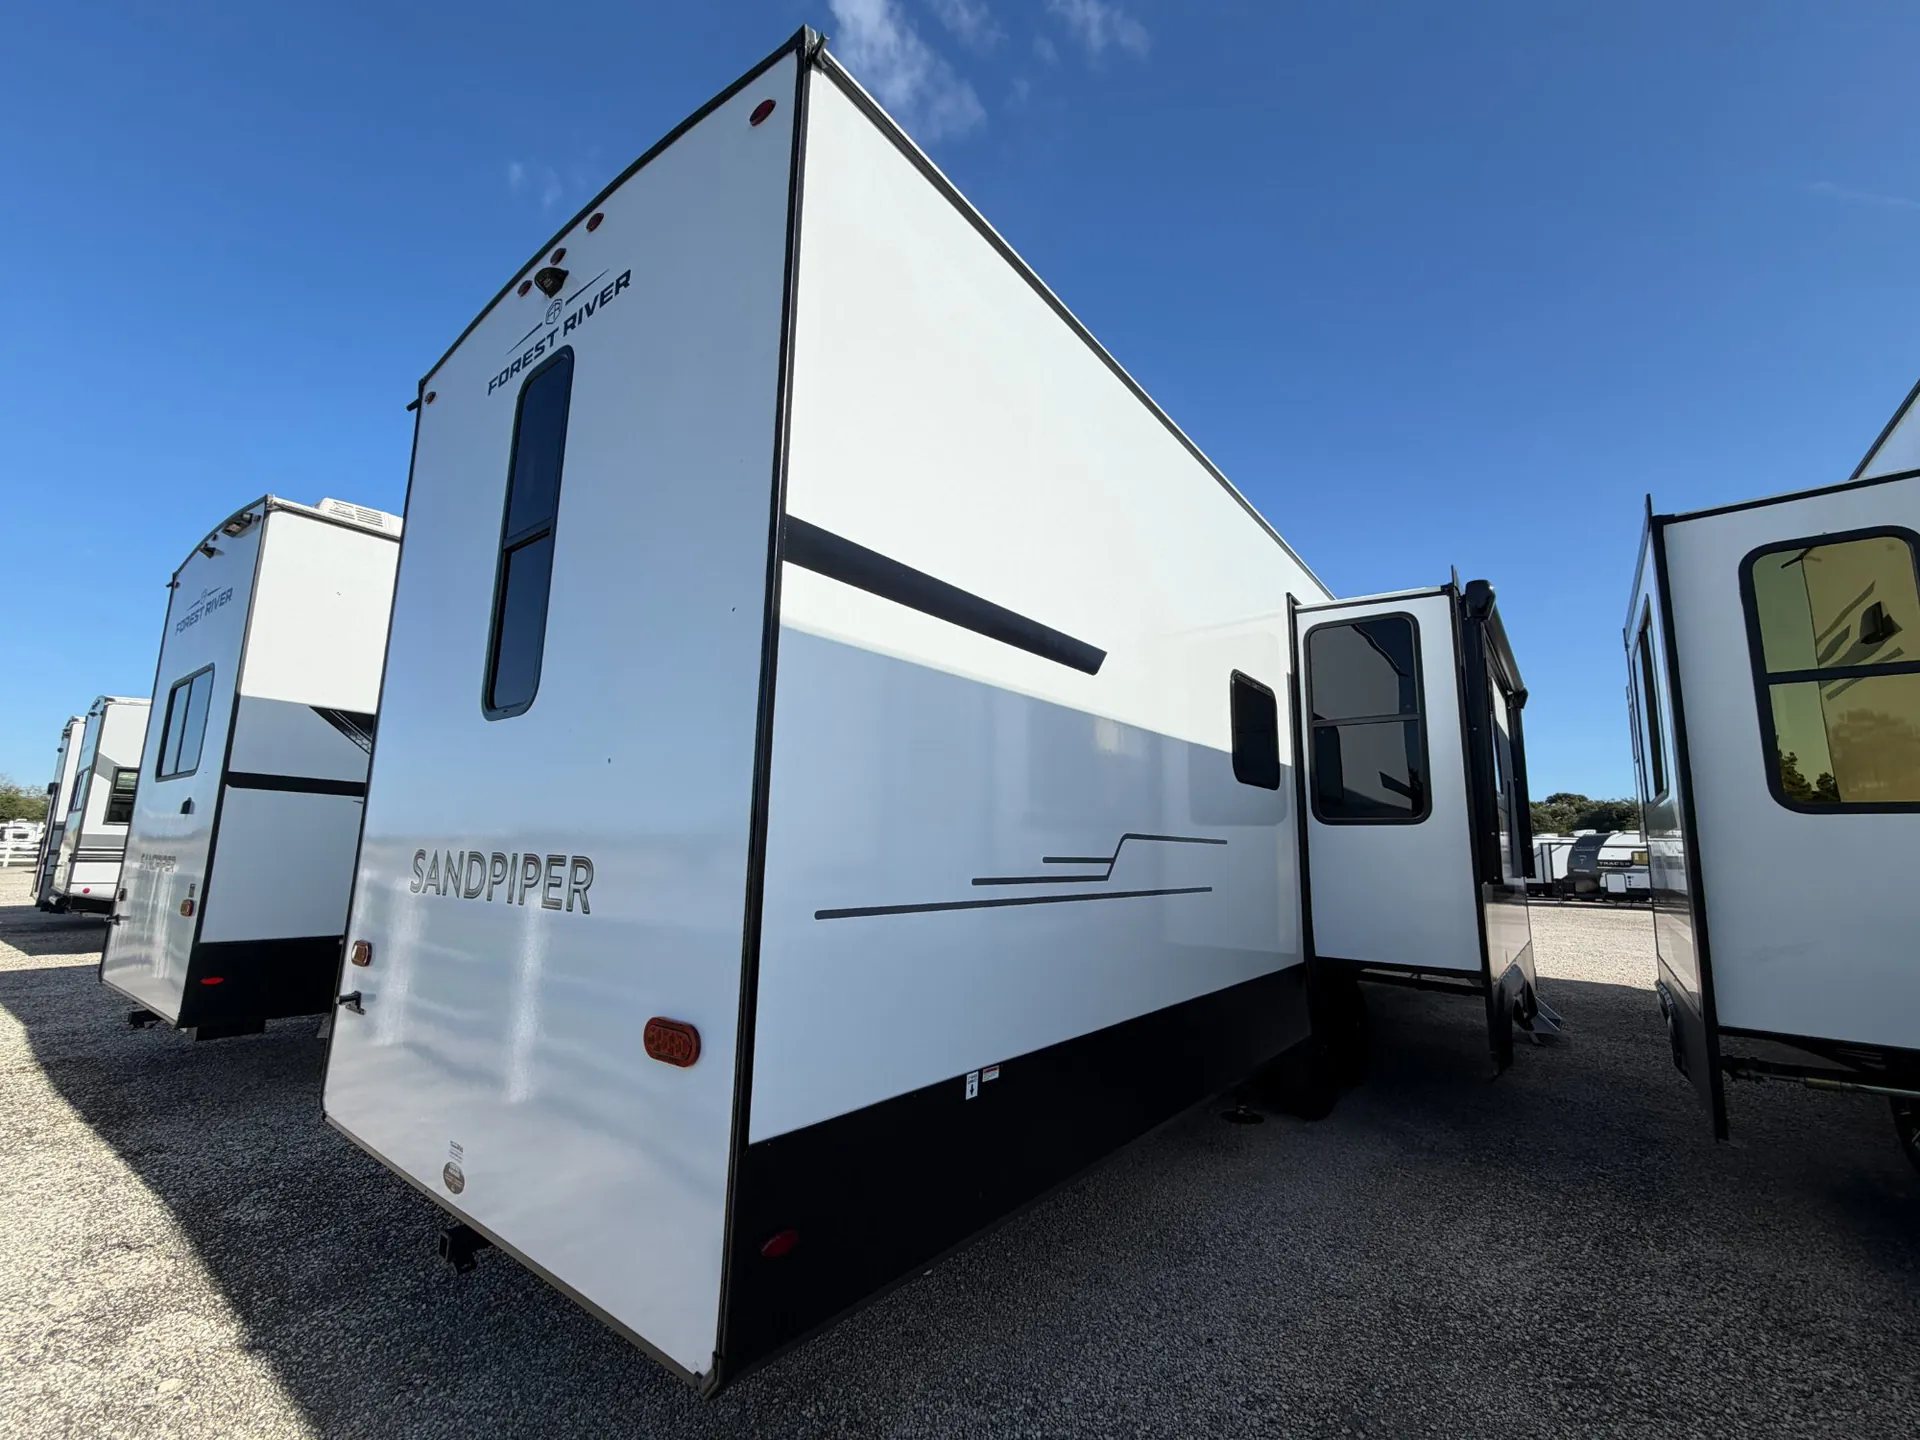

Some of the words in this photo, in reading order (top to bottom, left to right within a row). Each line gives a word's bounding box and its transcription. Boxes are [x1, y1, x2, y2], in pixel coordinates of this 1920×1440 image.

[487, 326, 559, 396] FOREST
[563, 269, 631, 337] RIVER
[175, 604, 205, 636] FOREST
[204, 586, 233, 616] RIVER
[409, 848, 595, 915] SANDPIPER
